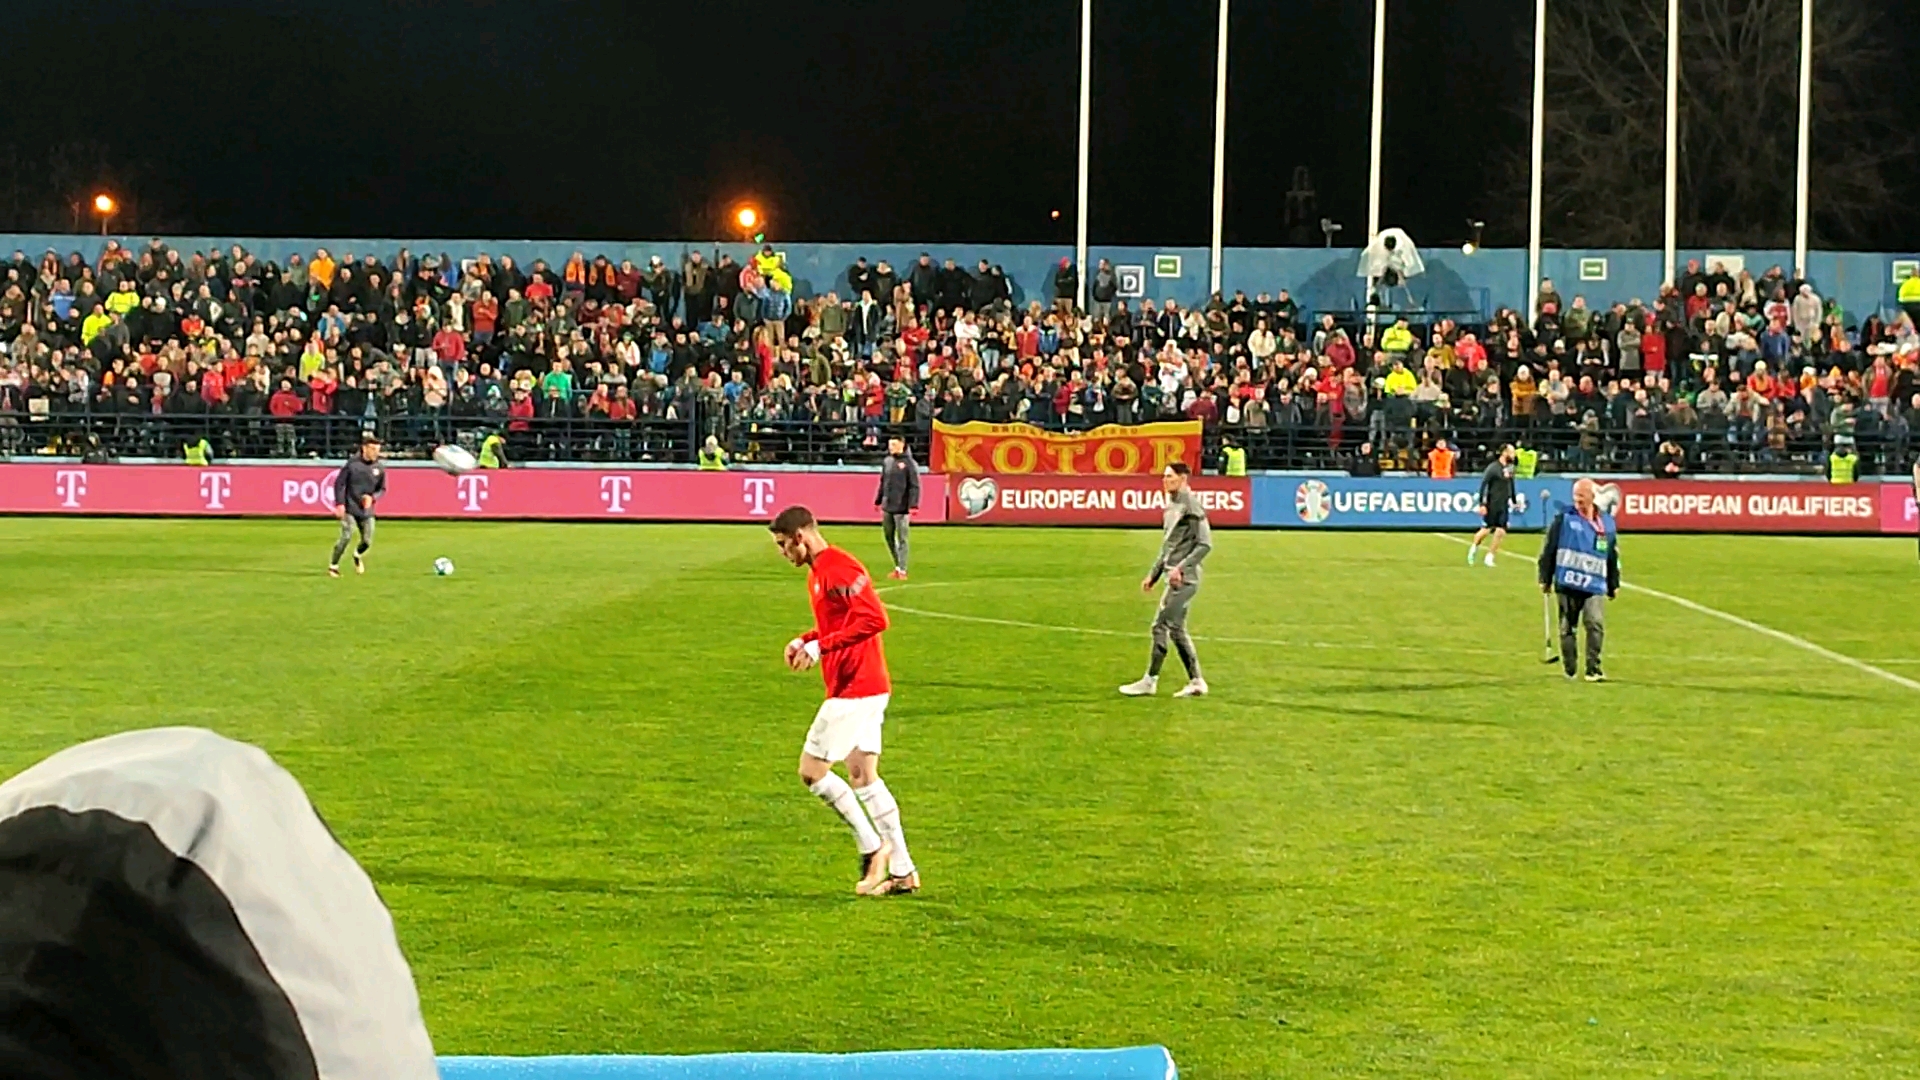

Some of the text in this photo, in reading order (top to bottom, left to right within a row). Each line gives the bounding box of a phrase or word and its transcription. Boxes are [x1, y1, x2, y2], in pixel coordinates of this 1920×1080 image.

[1123, 274, 1138, 291] D
[941, 436, 1186, 474] KOTOR
[56, 470, 87, 507] T
[200, 472, 231, 509] T
[457, 475, 488, 511] T
[601, 476, 632, 512] T
[743, 478, 775, 514] T
[1002, 489, 1116, 510] EUROPEAN
[1625, 494, 1873, 518] EUROPEAN QUALIFIERS
[1564, 570, 1593, 588] 837
